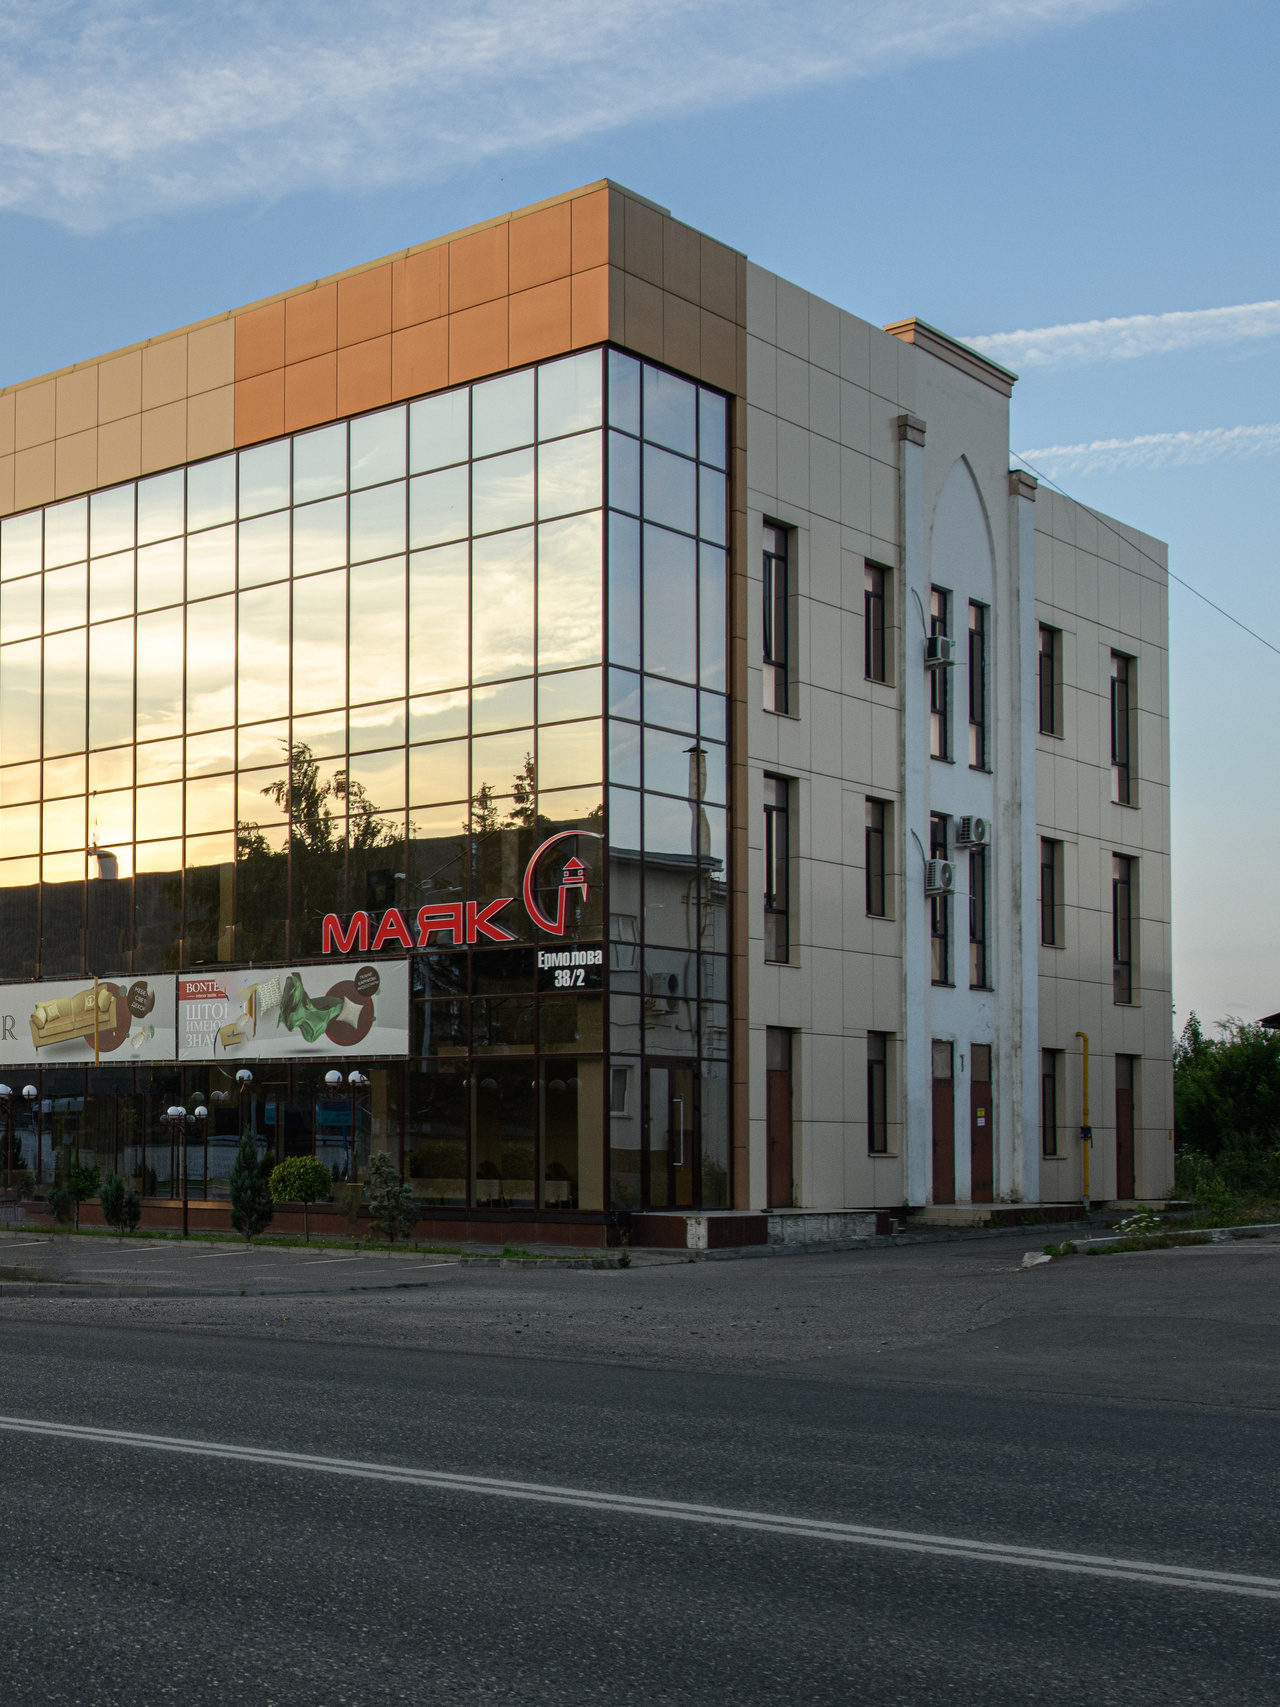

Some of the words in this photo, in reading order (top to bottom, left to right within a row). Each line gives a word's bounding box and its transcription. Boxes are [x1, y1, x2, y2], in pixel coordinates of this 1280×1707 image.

[322, 897, 518, 954] МАЯК
[538, 950, 603, 970] Ермолова
[554, 968, 586, 987] 38/2
[186, 1020, 223, 1031] ИМЕЮ
